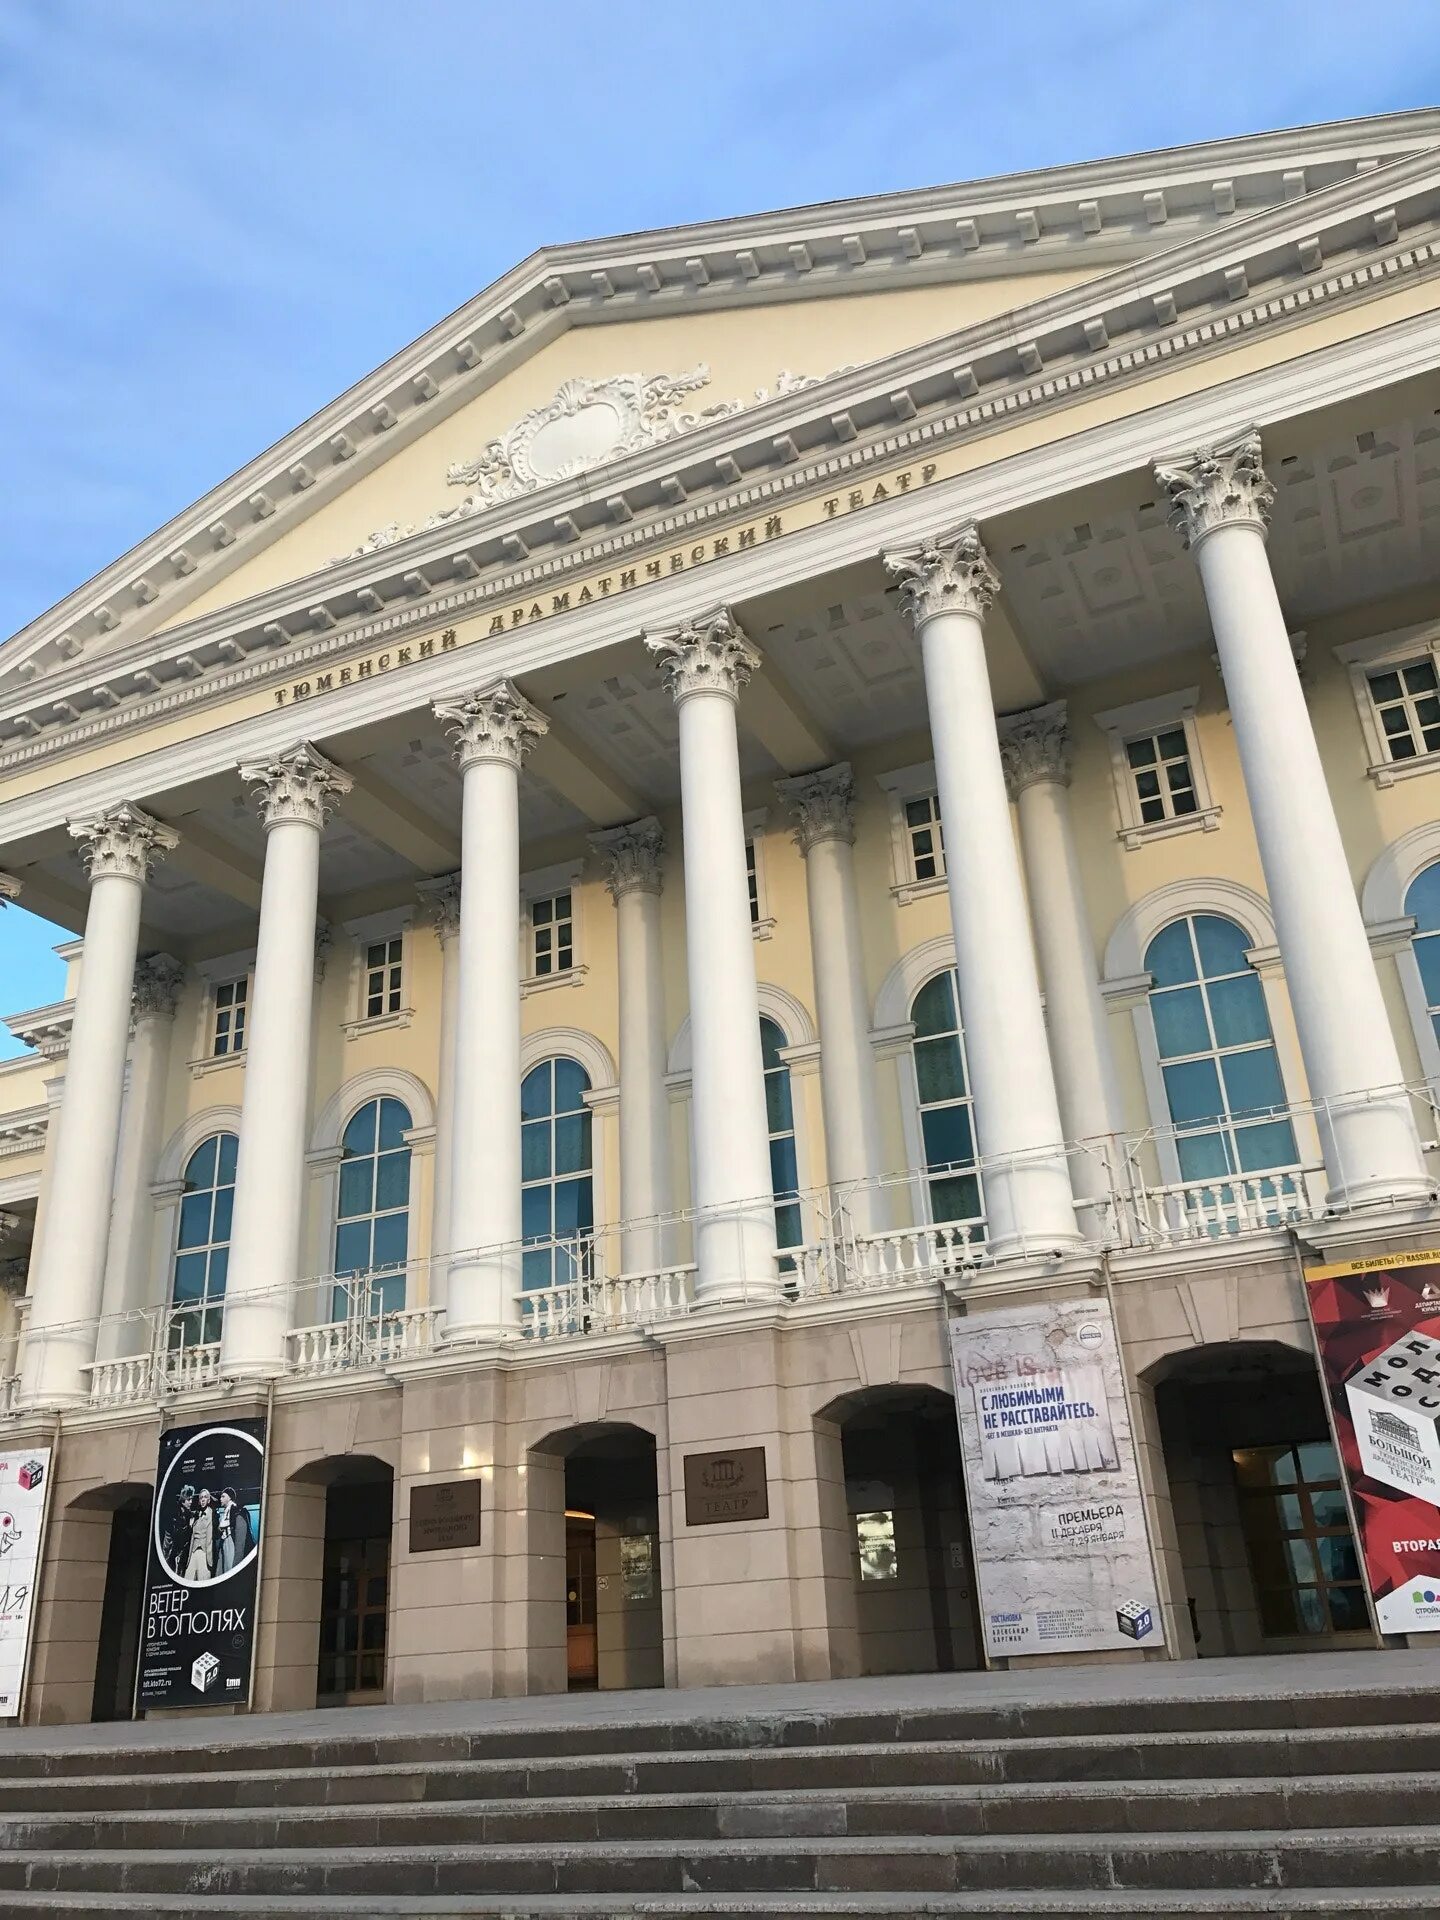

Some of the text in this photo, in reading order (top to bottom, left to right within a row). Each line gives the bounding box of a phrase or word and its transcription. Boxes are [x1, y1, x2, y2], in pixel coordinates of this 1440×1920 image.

[273, 462, 939, 706] ТЮМЕНСКИЙ ДРАМАТИЧЕСКИЙ ТЕАТР
[1351, 1261, 1364, 1270] ВСЕ
[1365, 1257, 1395, 1267] БИЛЕТЫ
[981, 1386, 1065, 1412] С ЛЮБИМЫМИ
[984, 1401, 1099, 1430] НЕ РАССТАВАЙТЕСЬ.
[1034, 1425, 1059, 1434] АНТРАКТА
[1368, 1434, 1432, 1470] БОЛЬШОЙ
[1388, 1465, 1422, 1486] ТЕАТР
[705, 1499, 748, 1513] ТЕАТР
[1058, 1505, 1124, 1525] ПРЕМЬЕРА
[1060, 1522, 1103, 1539] ДЕКАБРЯ
[1090, 1531, 1125, 1543] ЯНВАРЯ
[149, 1589, 189, 1614] ВЕТЕР
[147, 1608, 246, 1639] В ТОПОЛЯХ
[991, 1613, 1023, 1624] ПОСТАНОВКА
[1137, 1613, 1151, 1631] 2.0
[206, 1666, 218, 1683] 2.0
